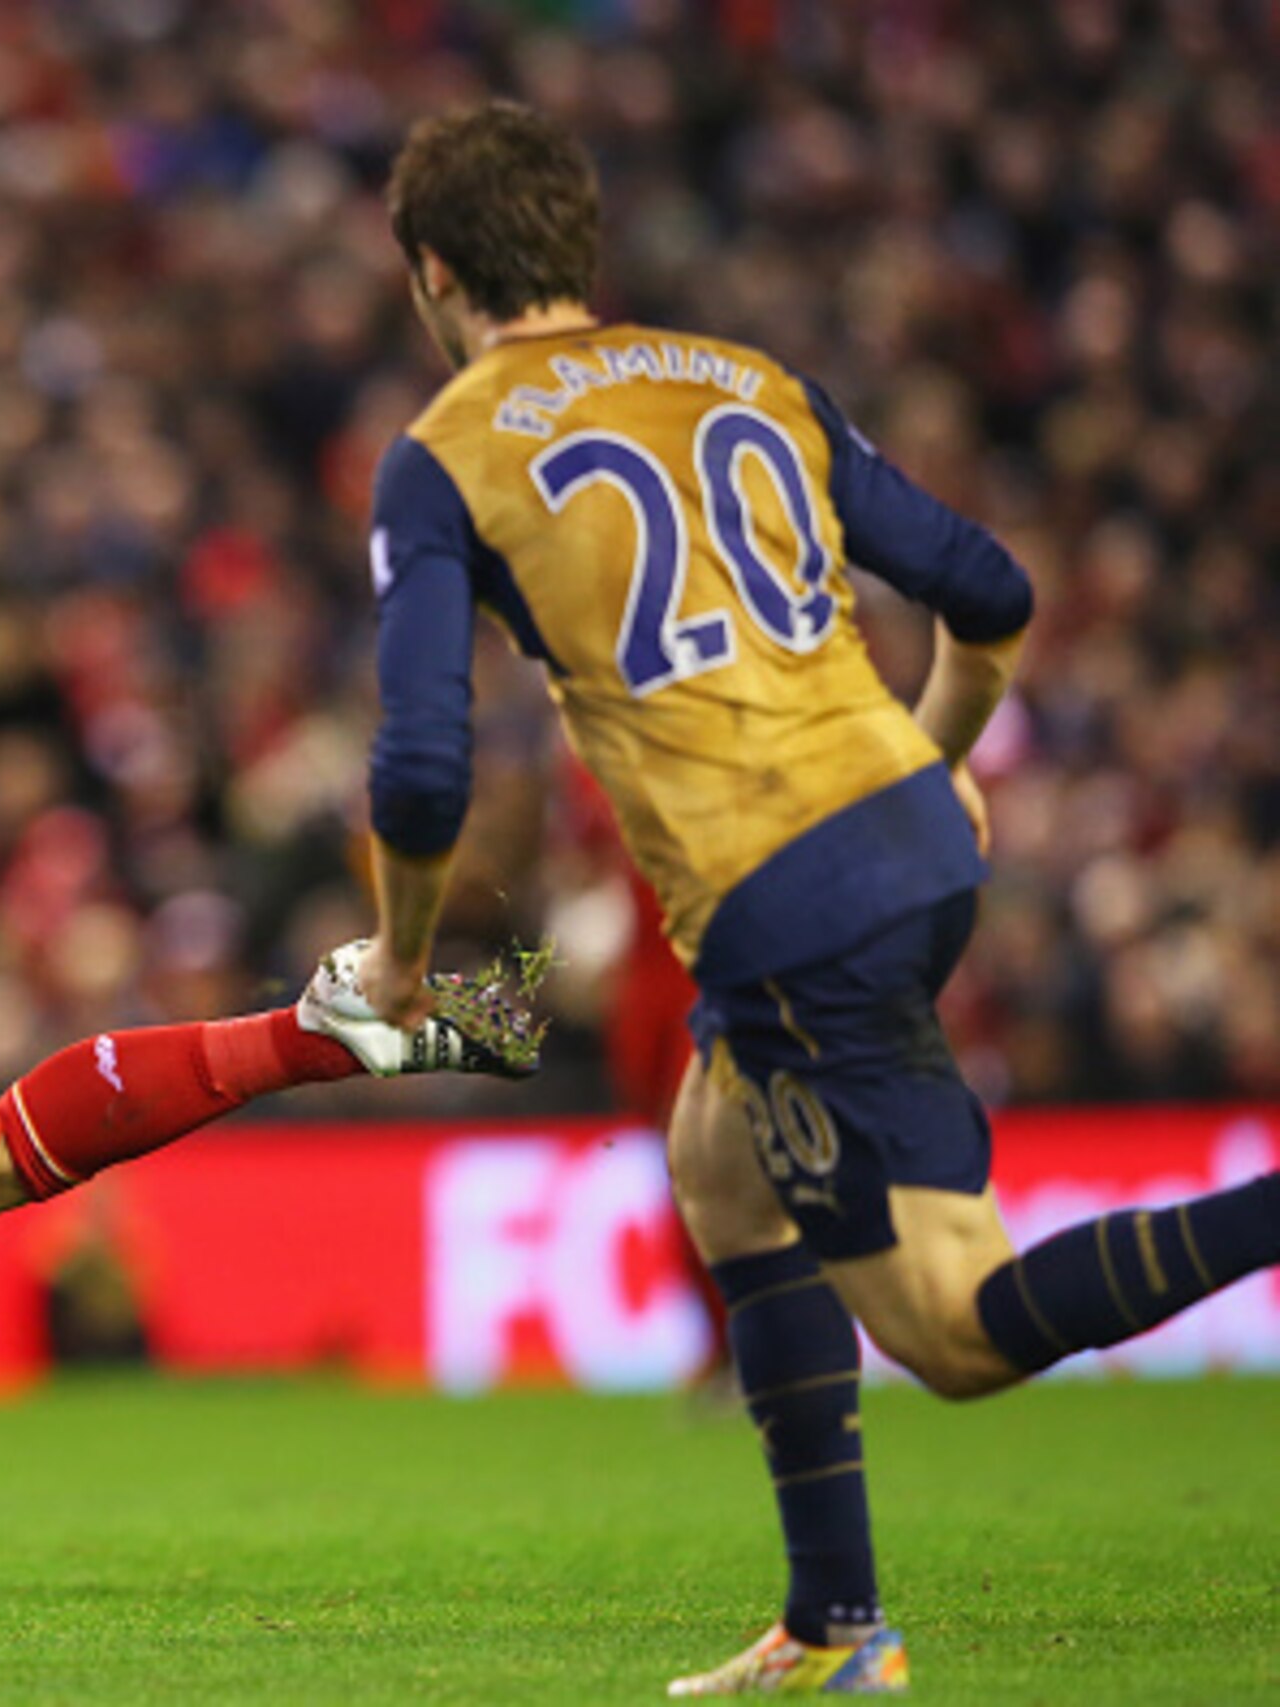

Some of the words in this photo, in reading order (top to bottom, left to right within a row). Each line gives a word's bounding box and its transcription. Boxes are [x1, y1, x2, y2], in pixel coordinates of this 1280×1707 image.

[492, 341, 764, 441] FLAMINI
[528, 403, 839, 698] 20
[424, 1131, 713, 1398] FC
